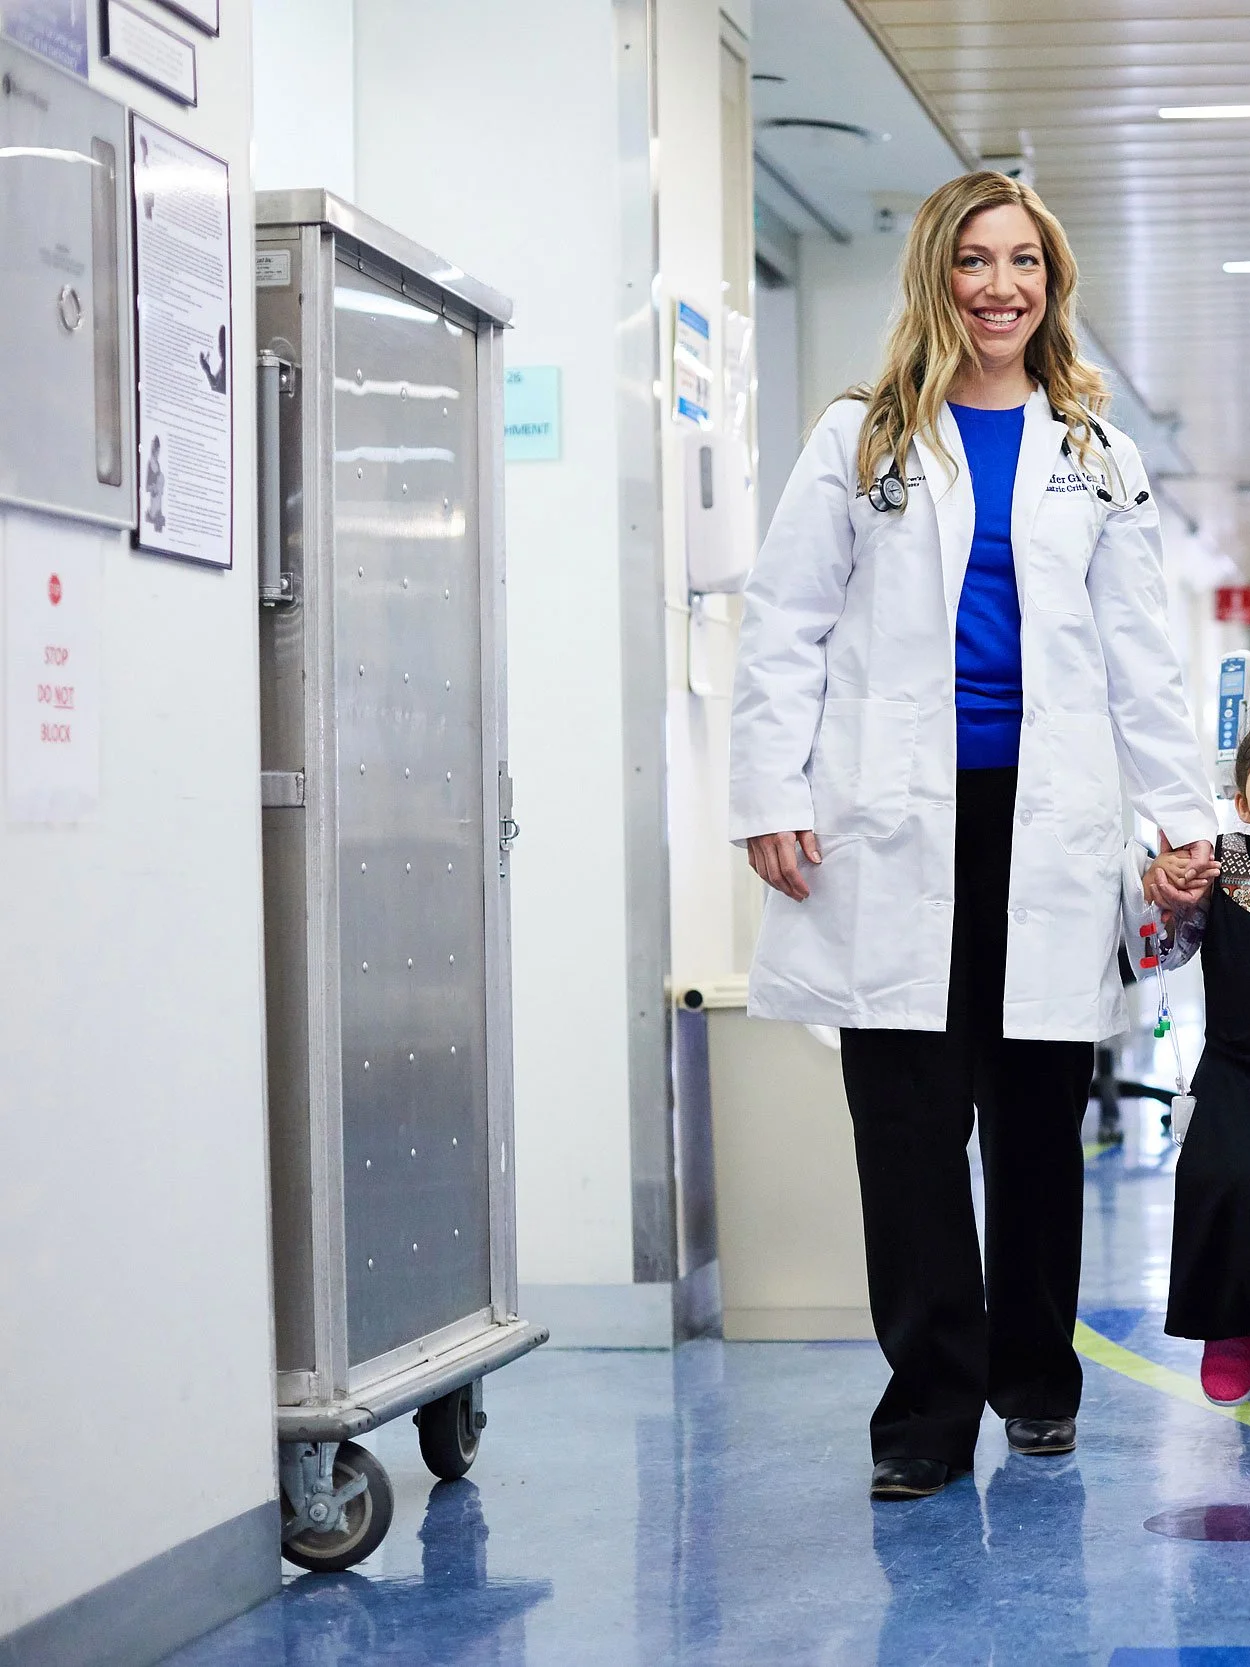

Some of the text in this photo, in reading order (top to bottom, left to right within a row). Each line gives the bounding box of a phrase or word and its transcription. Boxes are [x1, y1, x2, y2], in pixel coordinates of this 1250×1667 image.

[44, 646, 69, 665] STOP
[37, 684, 75, 706] DO NOT
[40, 722, 72, 742] BLOCK
